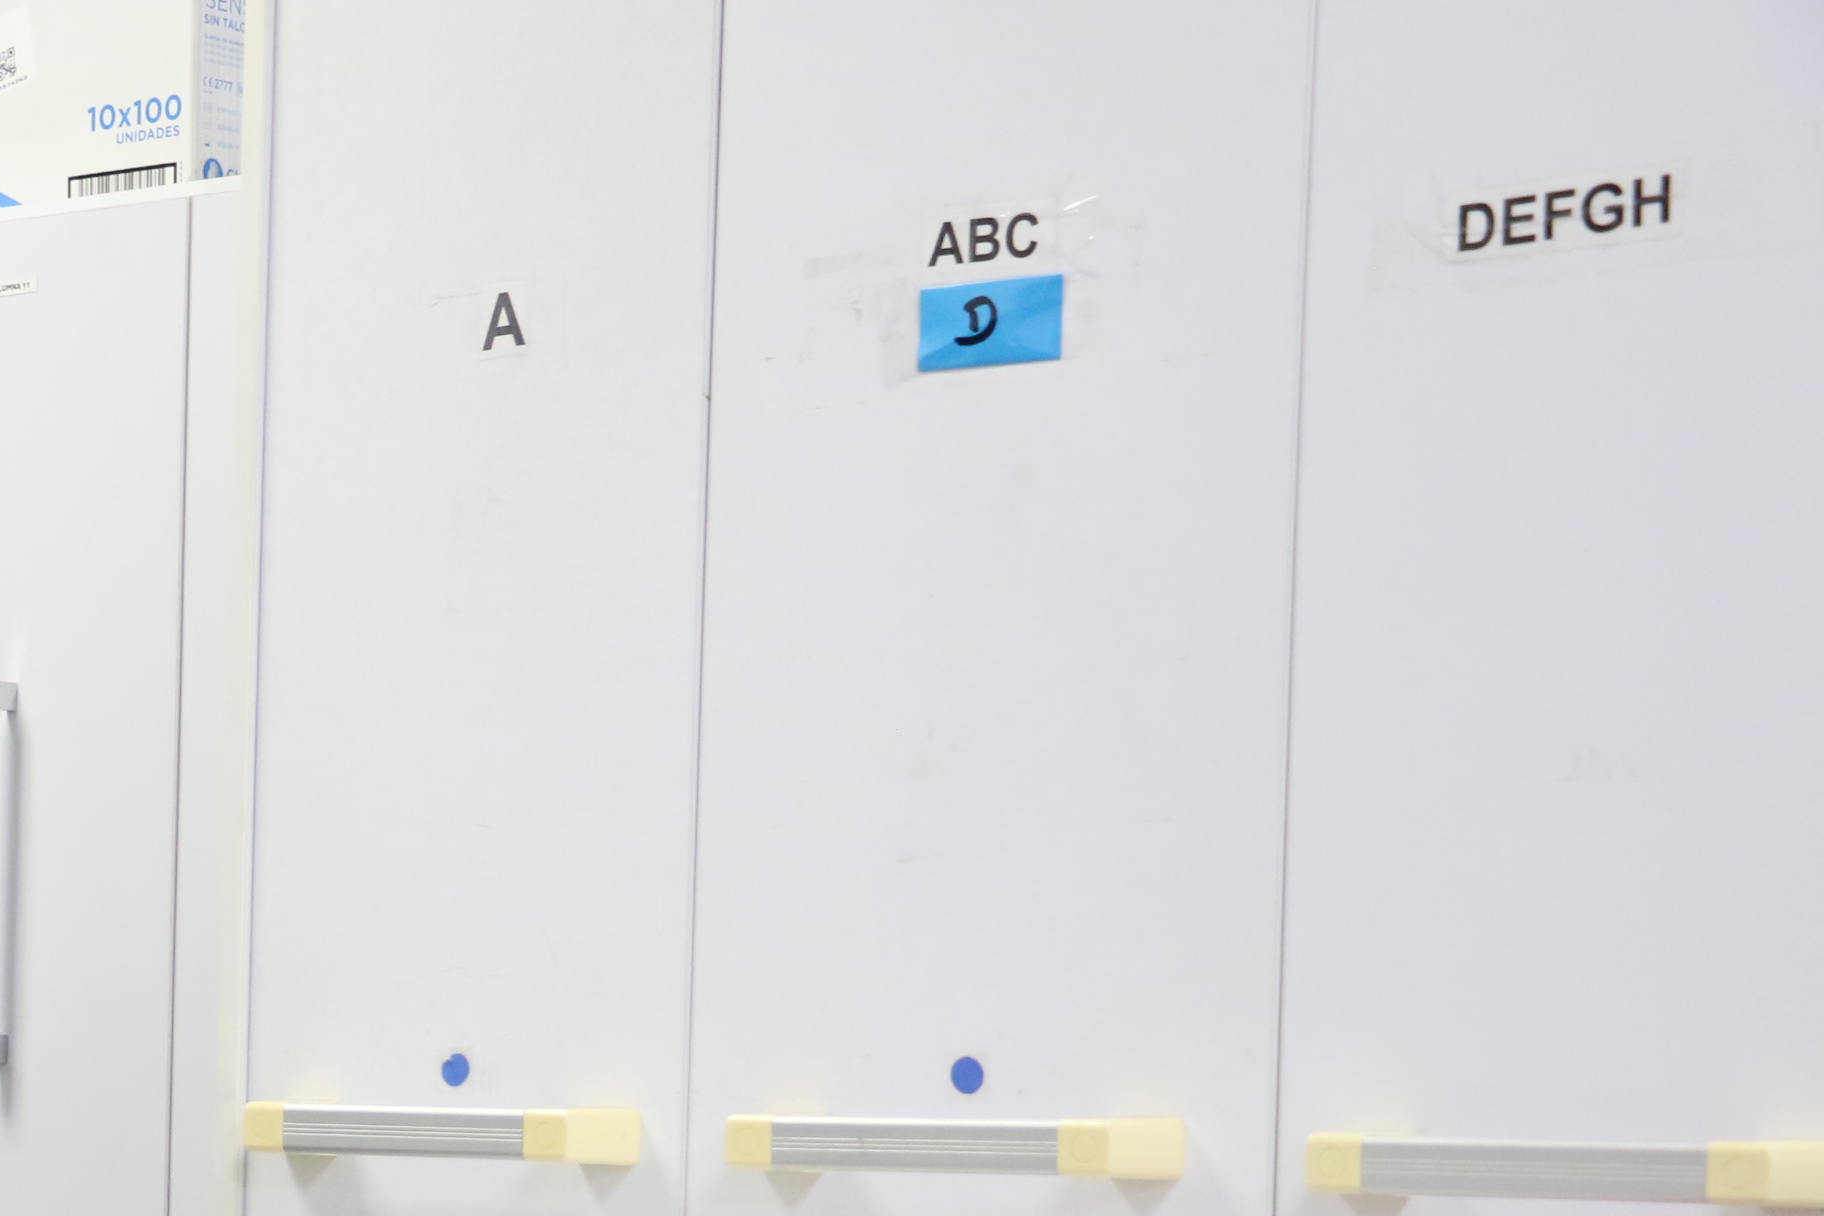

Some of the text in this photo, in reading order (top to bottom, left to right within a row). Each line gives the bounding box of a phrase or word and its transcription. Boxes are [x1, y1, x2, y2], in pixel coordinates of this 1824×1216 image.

[87, 94, 182, 132] 10x100
[116, 124, 180, 145] UNIDADES
[928, 212, 1039, 268] ABC
[1457, 173, 1672, 253] DEFGH
[481, 291, 526, 351] A
[954, 295, 998, 347] D
